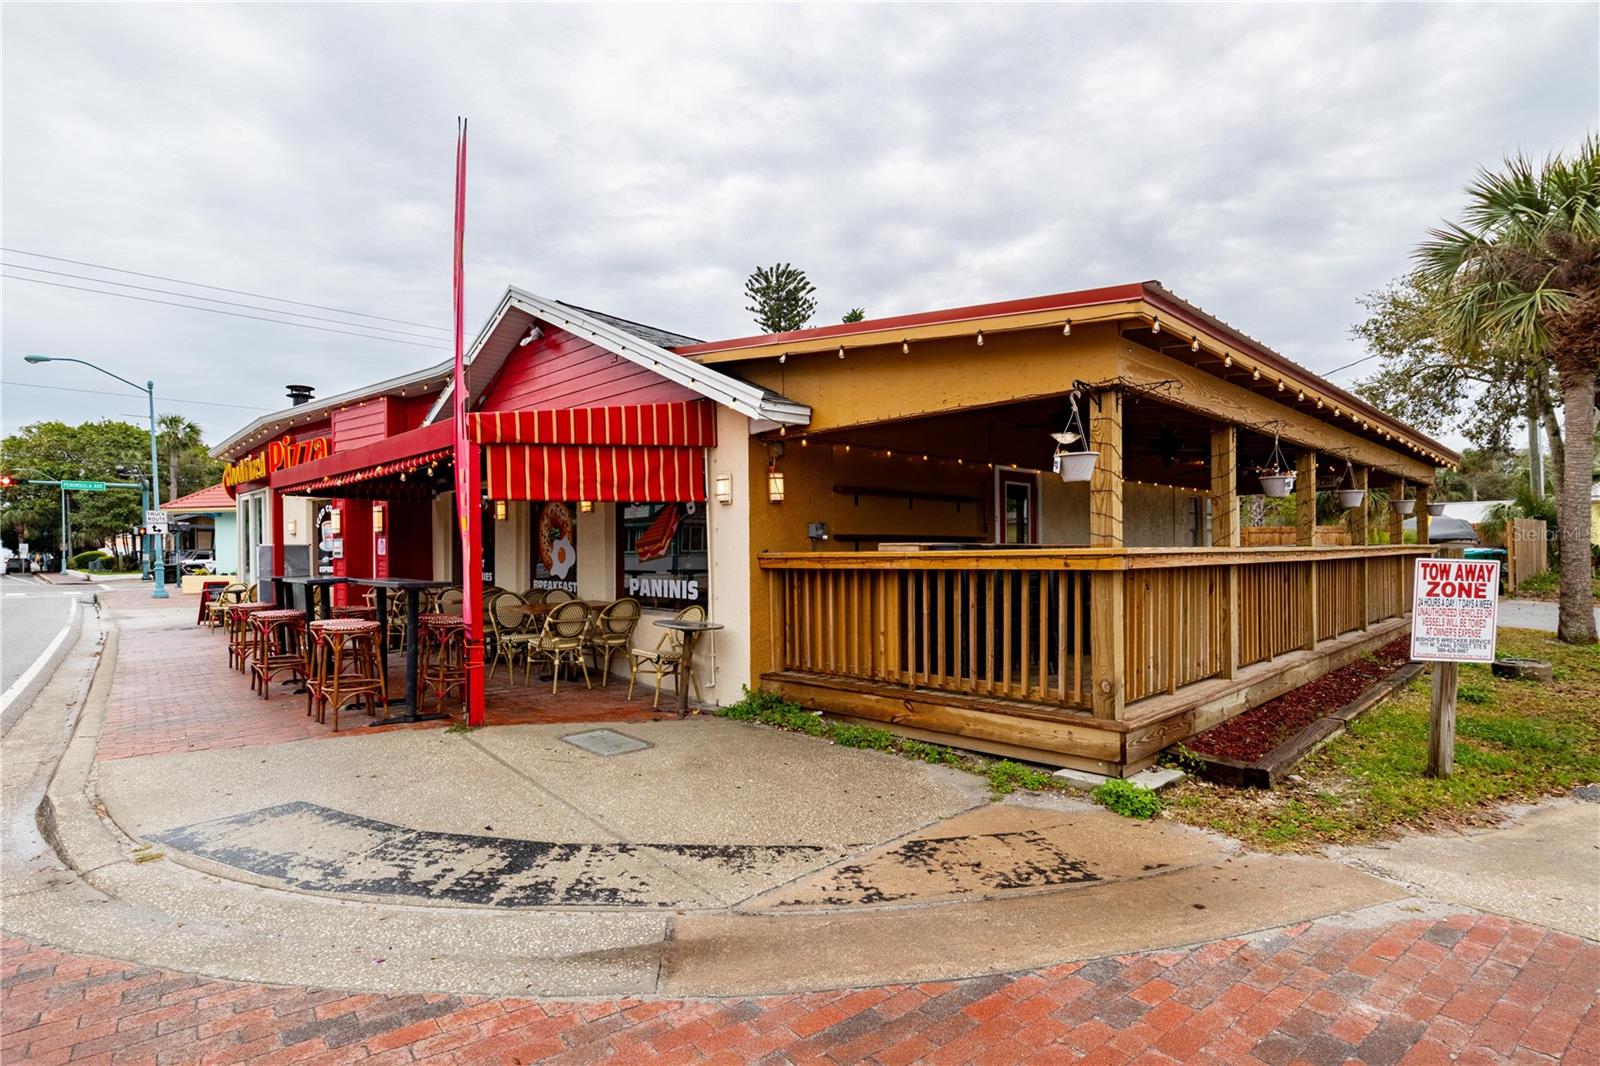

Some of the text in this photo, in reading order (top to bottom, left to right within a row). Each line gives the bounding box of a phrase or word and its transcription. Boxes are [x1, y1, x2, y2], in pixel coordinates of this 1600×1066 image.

[269, 435, 328, 473] Pizza
[1421, 563, 1495, 582] TOW AWAY
[533, 579, 577, 593] BREAKFAST
[629, 578, 699, 600] PANINIS
[1425, 581, 1488, 599] ZONE
[1418, 597, 1424, 607] 24
[1424, 598, 1441, 607] HOURS
[1446, 598, 1455, 608] DAY
[1462, 599, 1474, 608] DAYS
[1480, 600, 1492, 609] WEEK
[1418, 608, 1492, 618] UNAUTHORIZED VEHICLES OR
[1422, 617, 1486, 628] VESSELS WILL BE TOWED
[1426, 627, 1482, 638] AT OWNER'S EXPENSE
